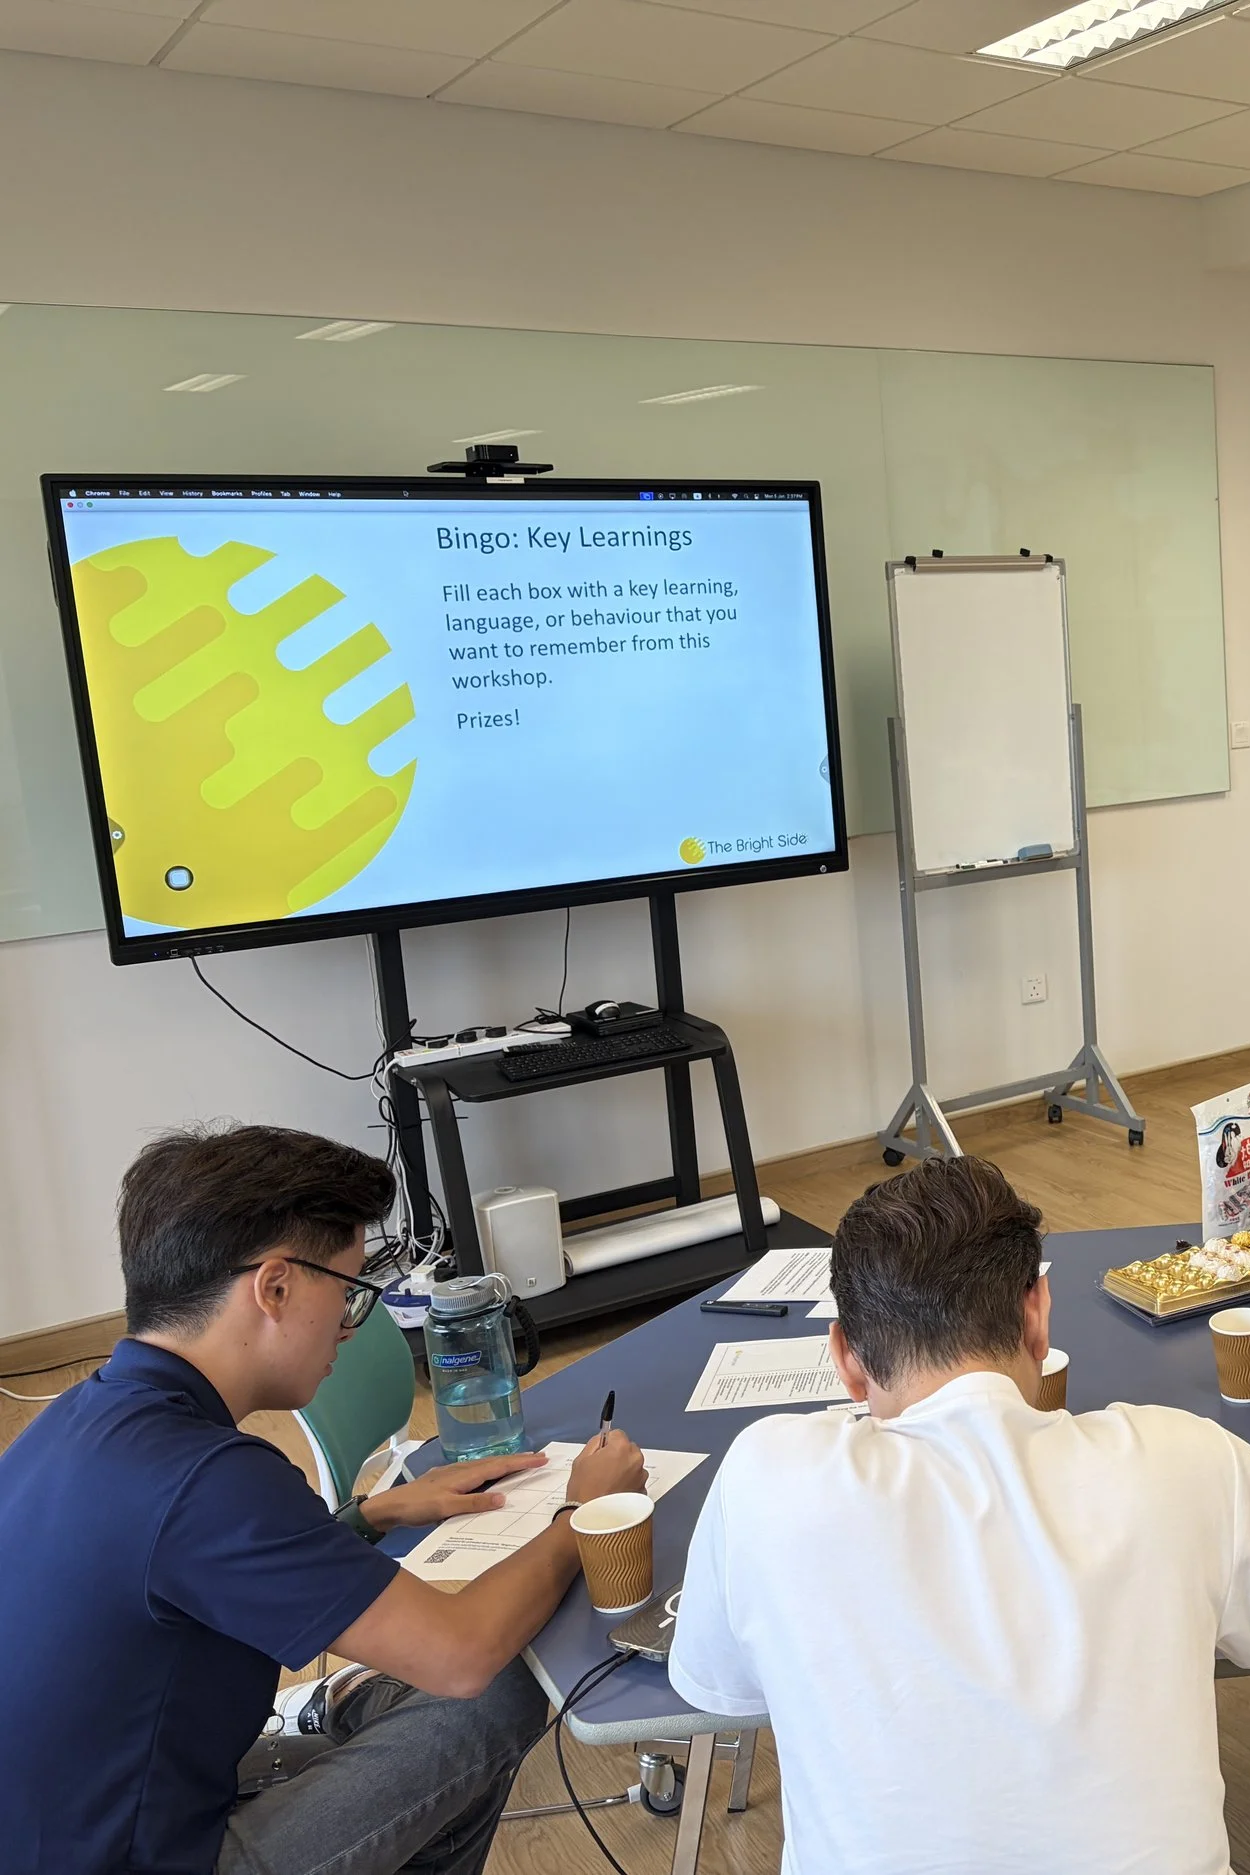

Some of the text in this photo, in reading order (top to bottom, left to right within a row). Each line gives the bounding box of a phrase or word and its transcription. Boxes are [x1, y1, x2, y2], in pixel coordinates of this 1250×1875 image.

[182, 490, 203, 498] History
[211, 490, 243, 498] Bookmarks
[251, 490, 272, 498] Profiles
[280, 490, 291, 498] Tab
[299, 490, 320, 498] Window
[328, 490, 341, 499] Help
[437, 525, 693, 554] Bingo: Key Learnings
[443, 578, 739, 602] Fill each box with a key learning,
[445, 606, 738, 635] language, or behaviour that you
[449, 632, 711, 661] want to remember from this
[452, 668, 553, 690] workshop.
[457, 708, 521, 730] Prizes!
[708, 832, 808, 854] The Bright Side
[1223, 1176, 1246, 1189] White
[441, 1355, 478, 1366] nalgene
